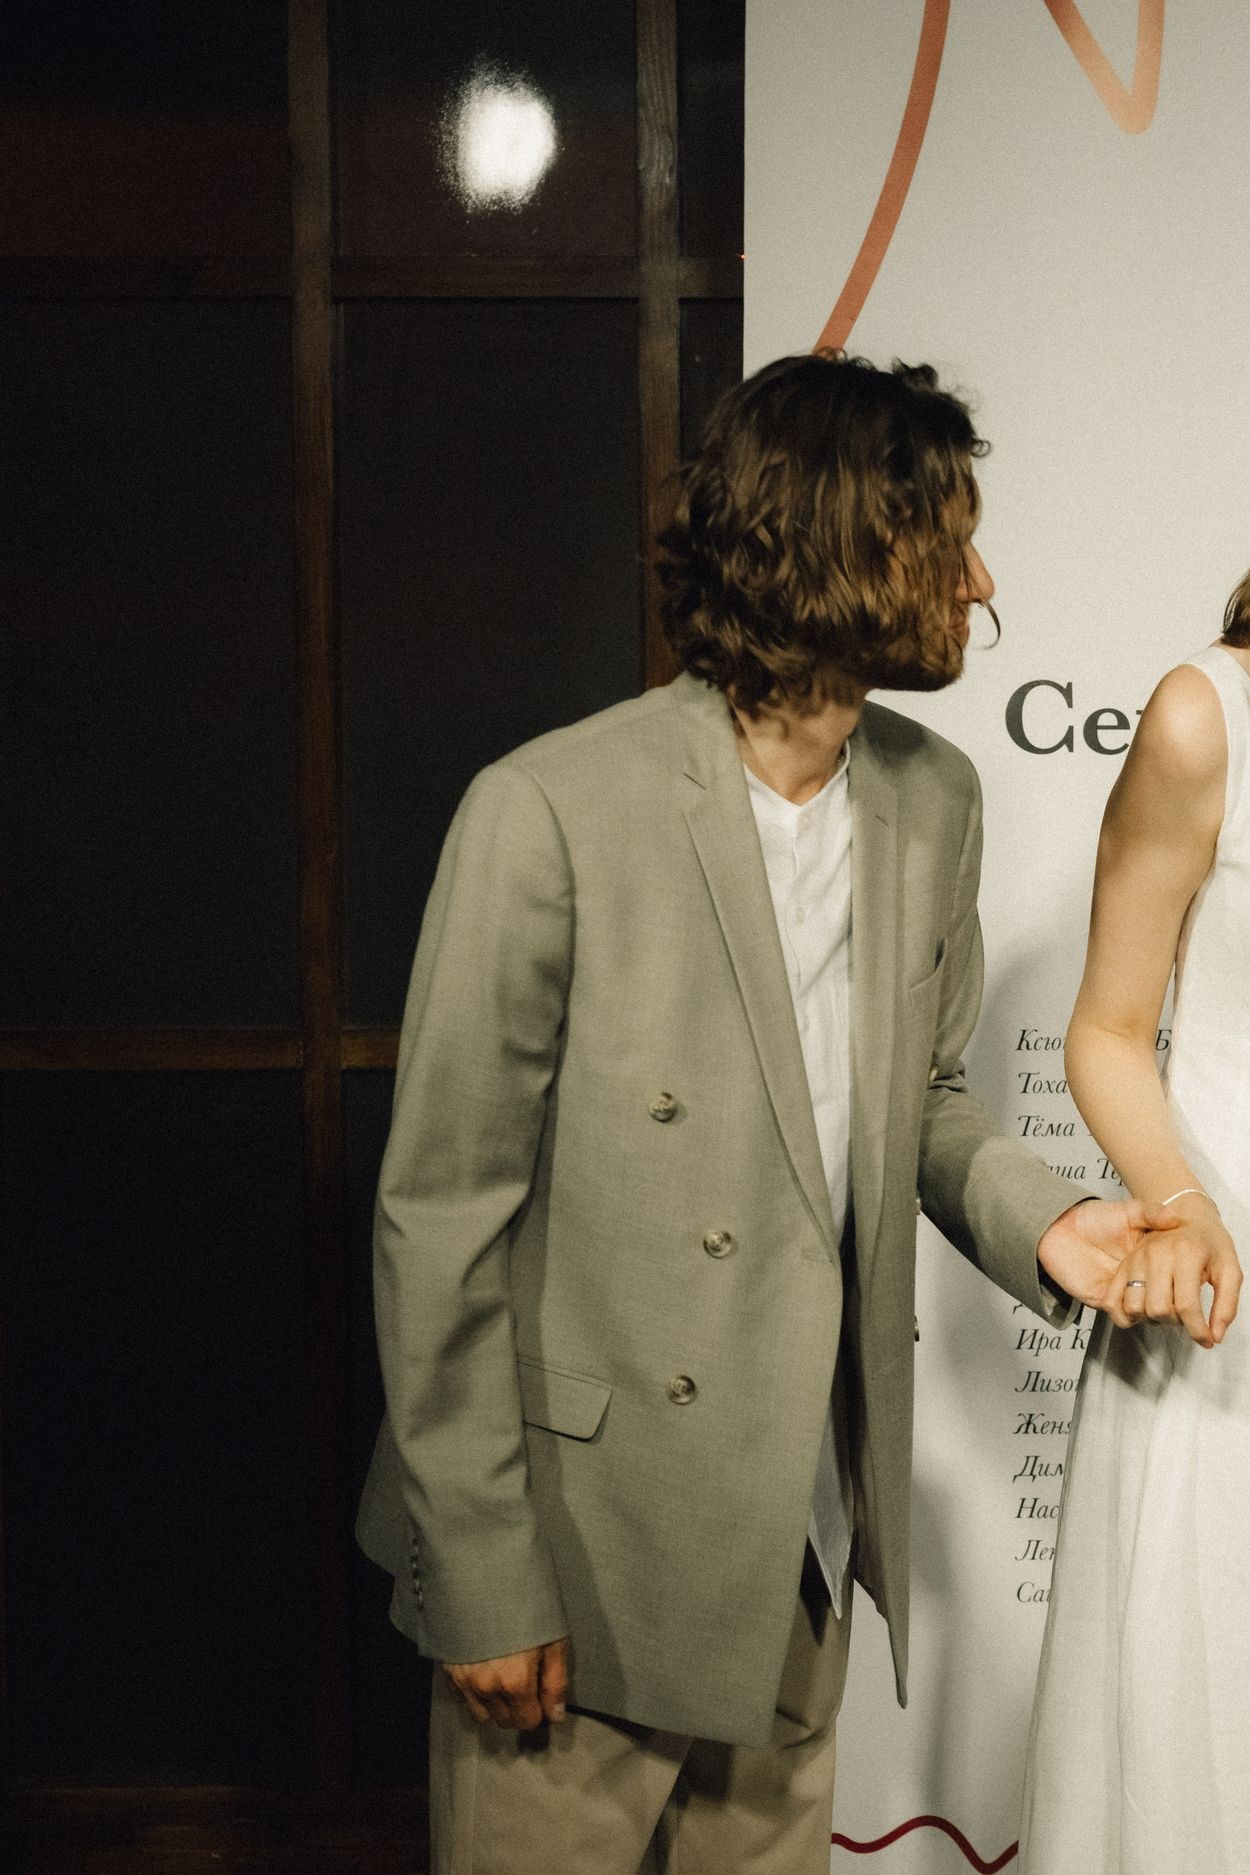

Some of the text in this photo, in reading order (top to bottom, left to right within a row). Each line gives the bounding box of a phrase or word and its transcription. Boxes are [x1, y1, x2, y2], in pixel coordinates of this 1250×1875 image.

[1018, 1072, 1067, 1094] Тоха
[1018, 1115, 1075, 1137] Тёма
[1015, 1328, 1062, 1356] Ира
[1014, 1371, 1079, 1392] Лизо
[1012, 1456, 1064, 1483] Дим
[1015, 1497, 1060, 1519] Нас
